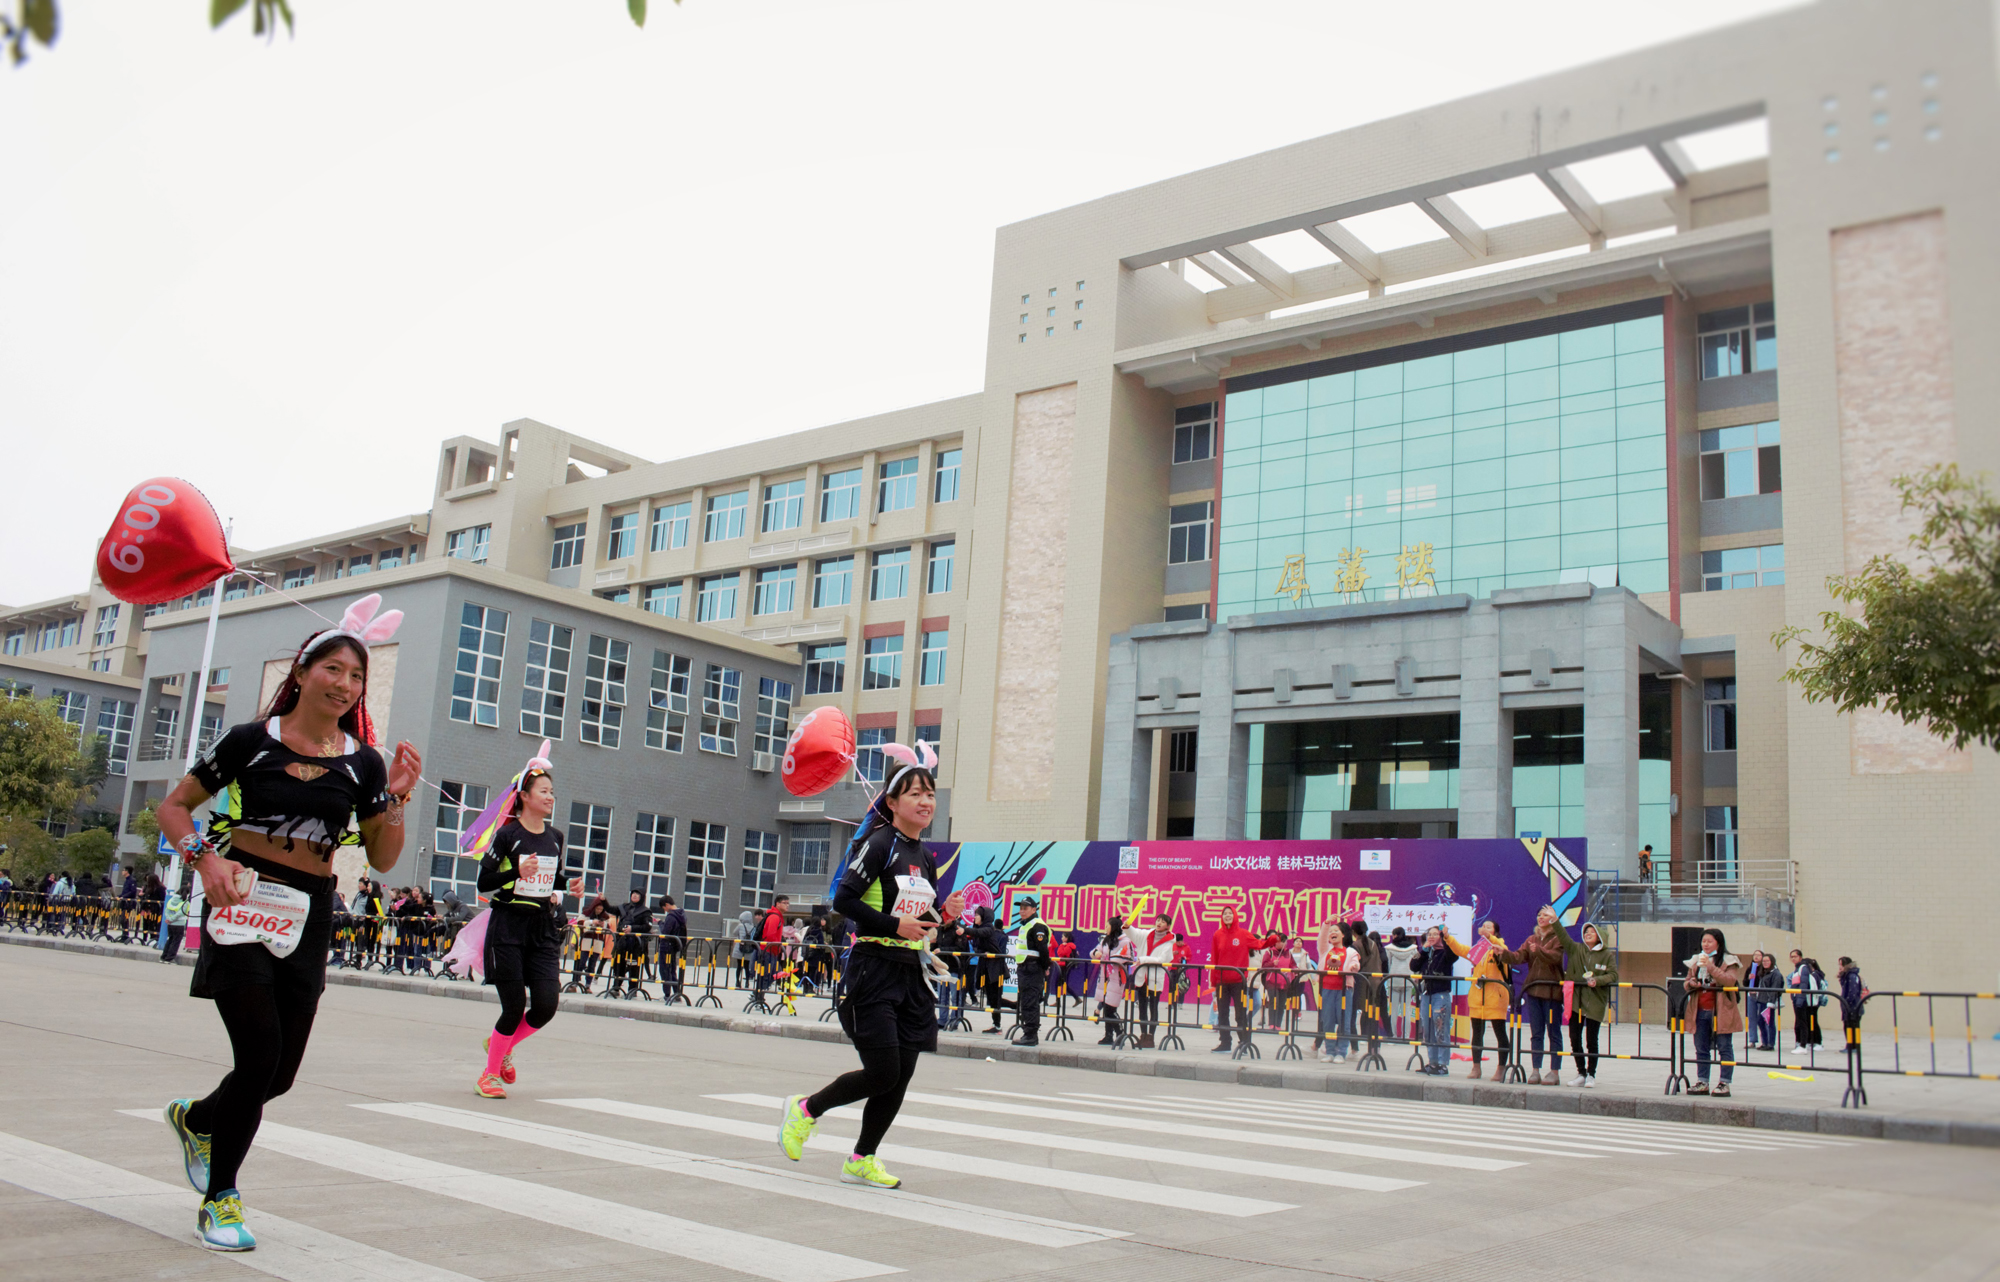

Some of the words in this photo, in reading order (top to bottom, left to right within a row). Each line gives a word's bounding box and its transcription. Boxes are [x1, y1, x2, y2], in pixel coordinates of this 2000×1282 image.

[108, 484, 176, 574] 6:00
[1209, 855, 1272, 870] 山水文化城
[1277, 855, 1342, 870] 桂林马拉松
[518, 873, 555, 885] A5105
[257, 889, 275, 897] GUILIN
[214, 907, 292, 936] A5062
